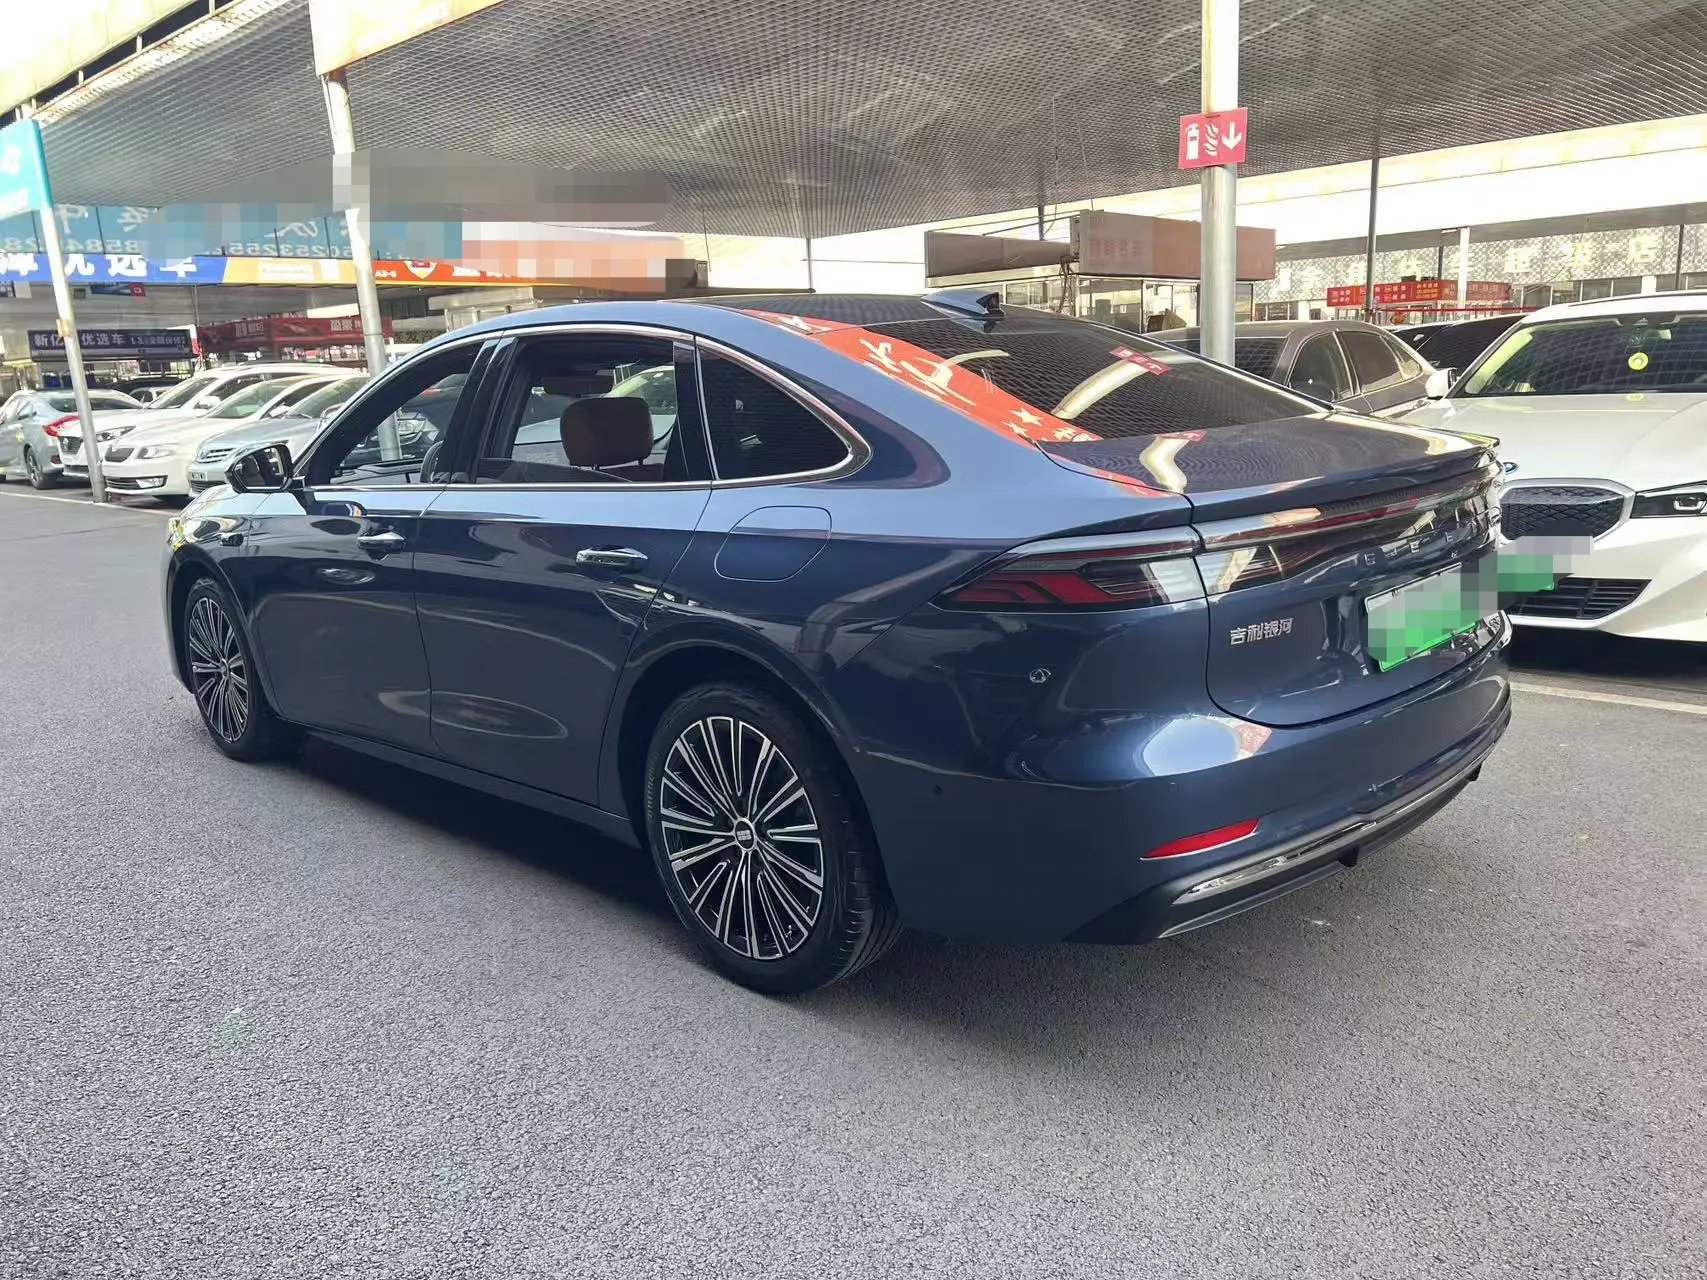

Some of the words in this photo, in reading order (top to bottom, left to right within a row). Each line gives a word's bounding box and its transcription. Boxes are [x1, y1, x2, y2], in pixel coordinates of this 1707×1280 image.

[34, 332, 126, 347] 新亿优选车
[1230, 617, 1294, 646] 吉利银河
